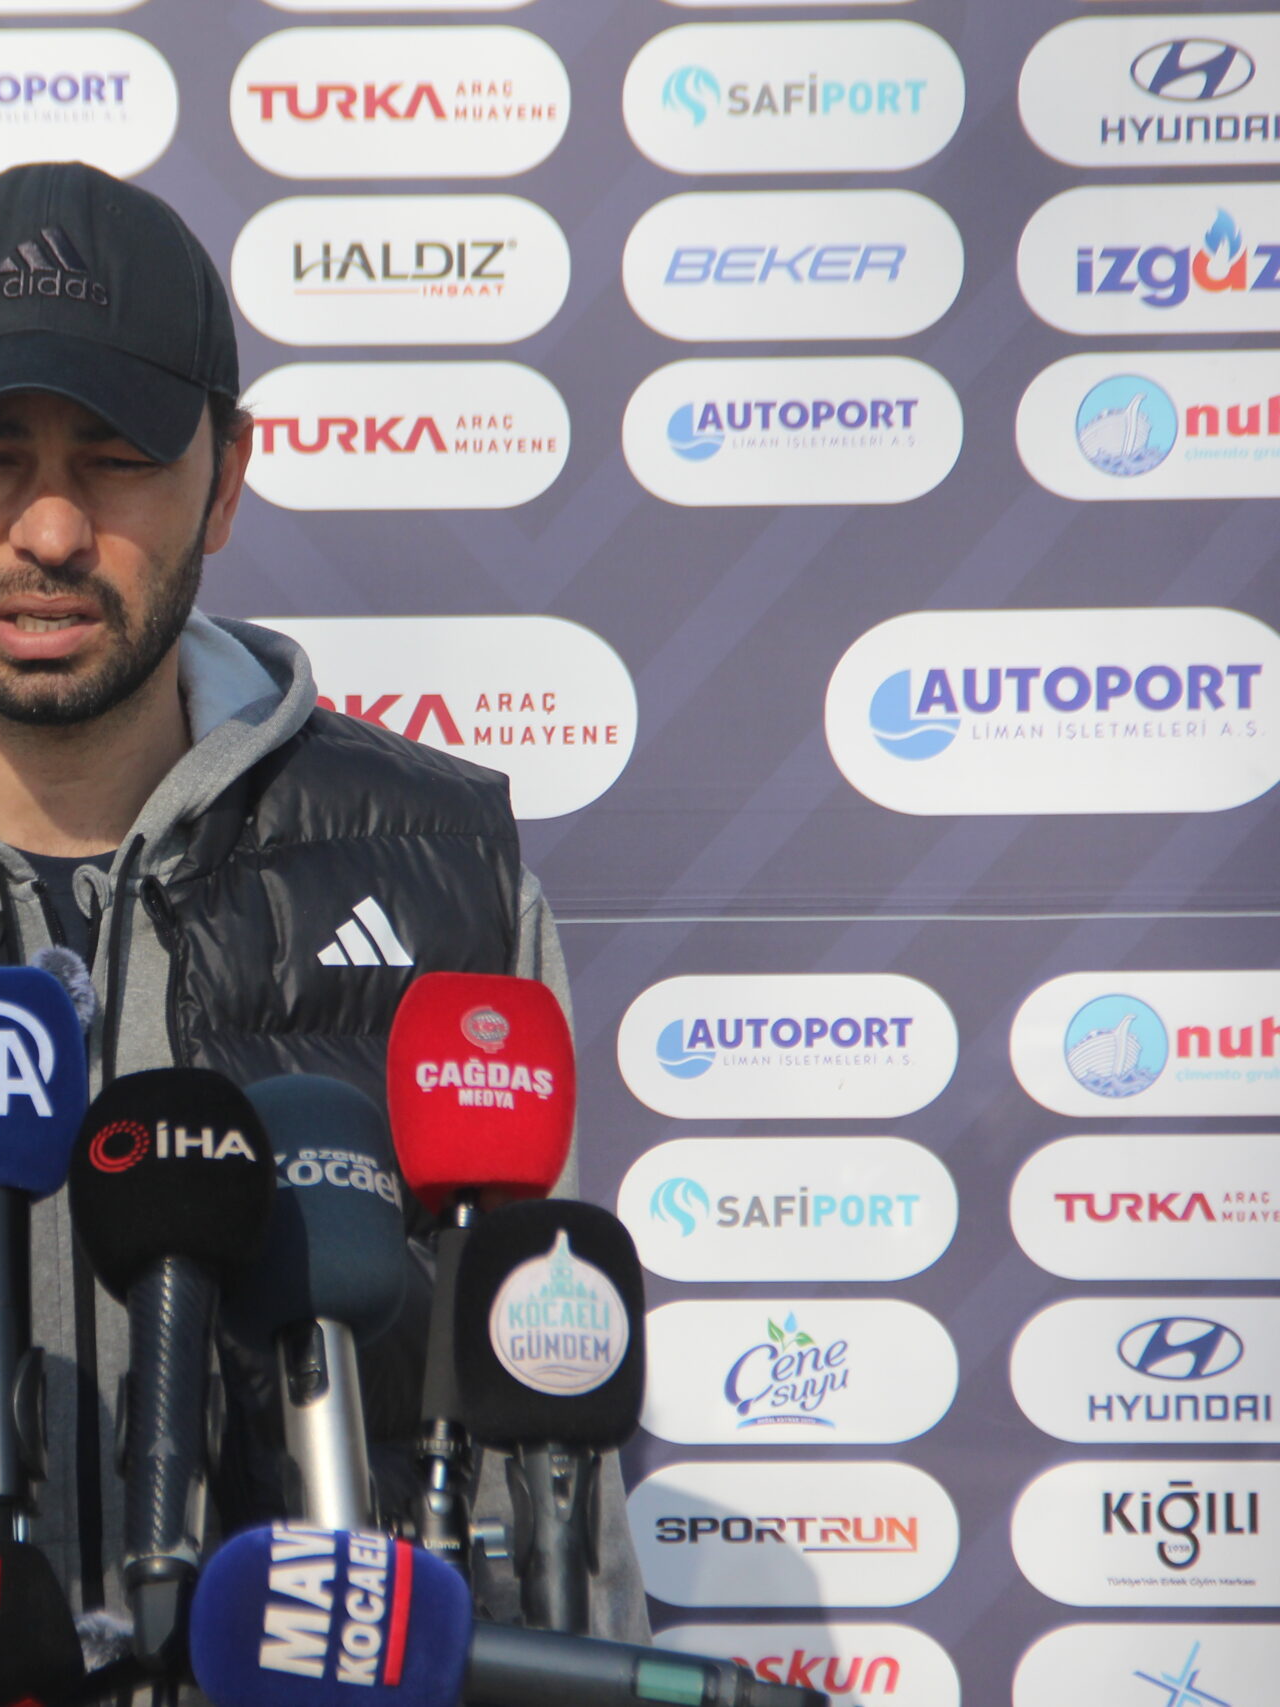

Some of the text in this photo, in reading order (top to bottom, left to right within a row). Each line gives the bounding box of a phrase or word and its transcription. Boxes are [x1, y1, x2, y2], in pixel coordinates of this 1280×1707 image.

[246, 82, 448, 122] TURKA
[726, 73, 928, 118] SAFİPORT
[454, 105, 558, 122] MUAYENE
[292, 241, 506, 282] HALDIZ
[663, 243, 908, 286] BEKER
[696, 398, 920, 433] AUTOPORT
[253, 415, 449, 455] TURKA
[454, 437, 558, 454] MUAYENE
[474, 692, 557, 714] ARAÇ
[914, 663, 1263, 715] AUTOPORT
[473, 725, 619, 746] MUAYENE
[972, 720, 1046, 741] LİMAN
[686, 1016, 914, 1051] AUTOPORT
[415, 1056, 554, 1100] ÇAĞDAŞ
[458, 1087, 515, 1110] MEDYA
[715, 1186, 921, 1228] SAFİPORT
[1053, 1192, 1217, 1223] TURKA
[509, 1331, 612, 1364] GÜNDEM
[1087, 1394, 1273, 1422] HYUNDAI
[655, 1515, 918, 1551] SPORTRUN
